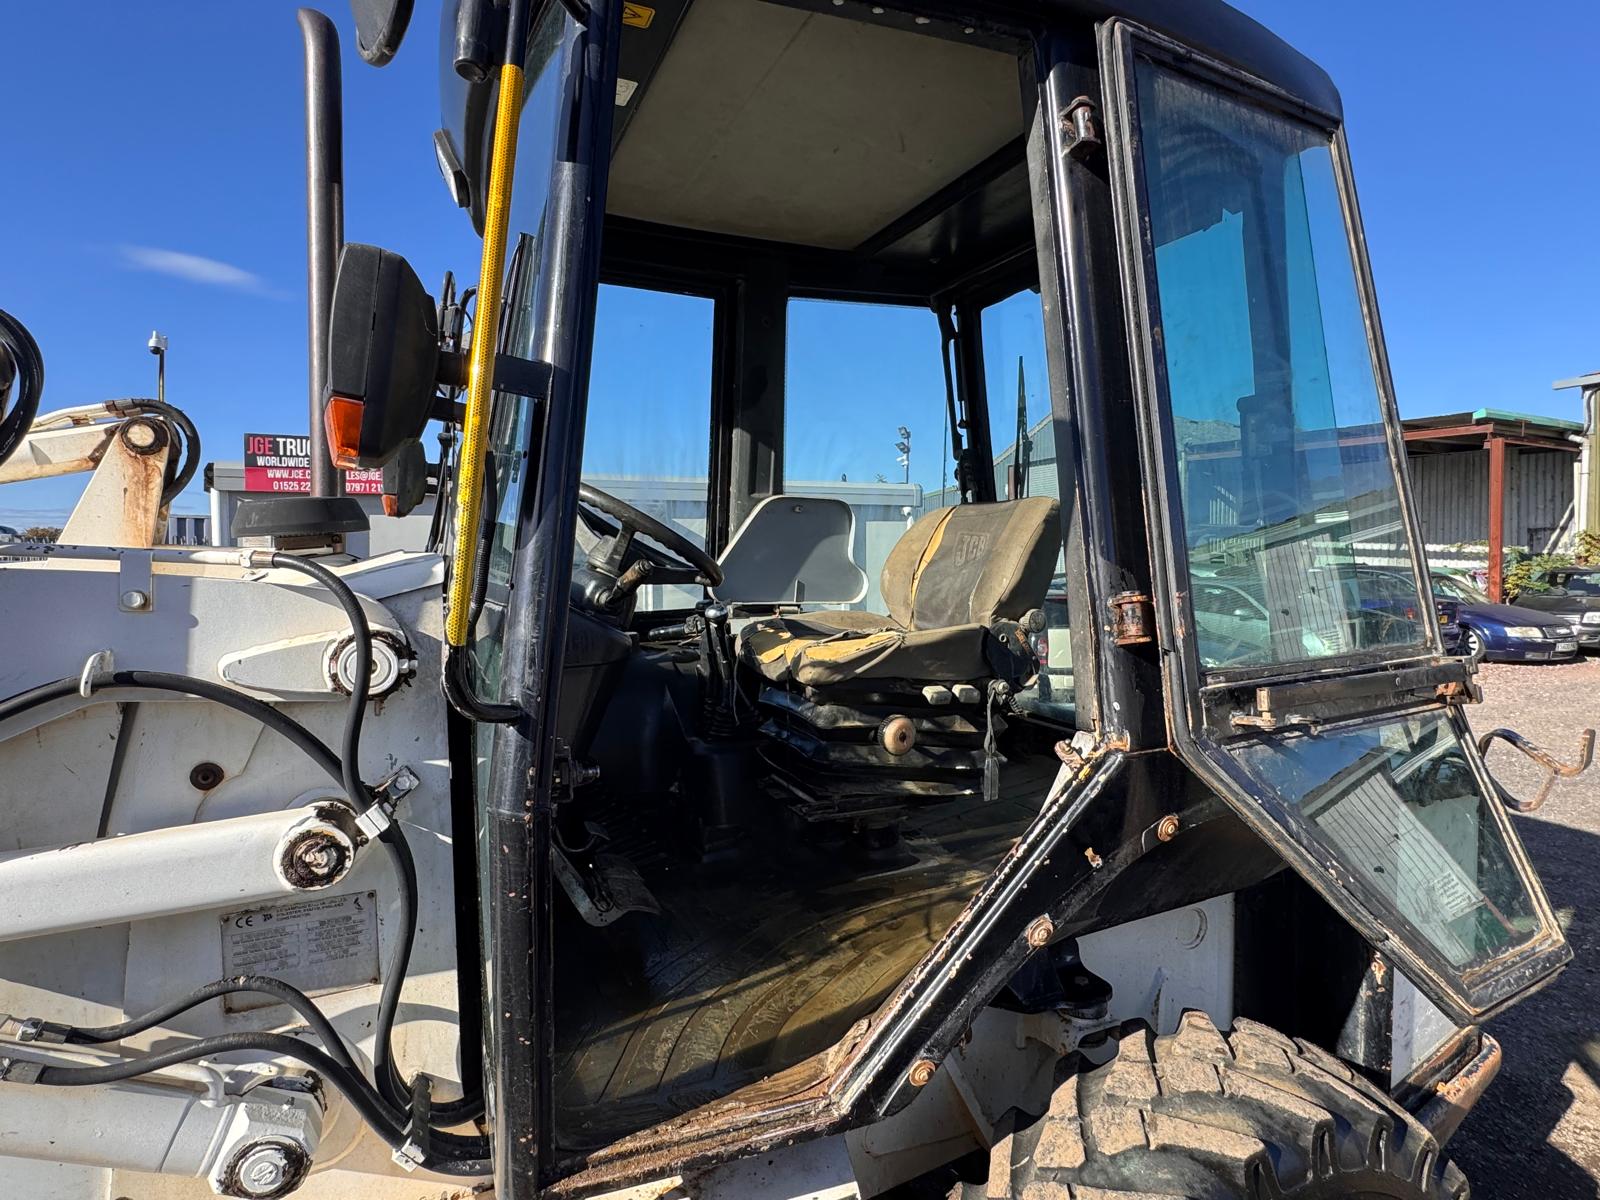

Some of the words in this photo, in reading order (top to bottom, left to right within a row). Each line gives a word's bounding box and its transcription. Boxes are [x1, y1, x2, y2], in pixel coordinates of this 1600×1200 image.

[247, 437, 274, 455] JGE
[256, 456, 310, 467] WORLDWIDE
[273, 481, 299, 490] 01525
[955, 534, 988, 567] JCB
[235, 915, 254, 929] CE
